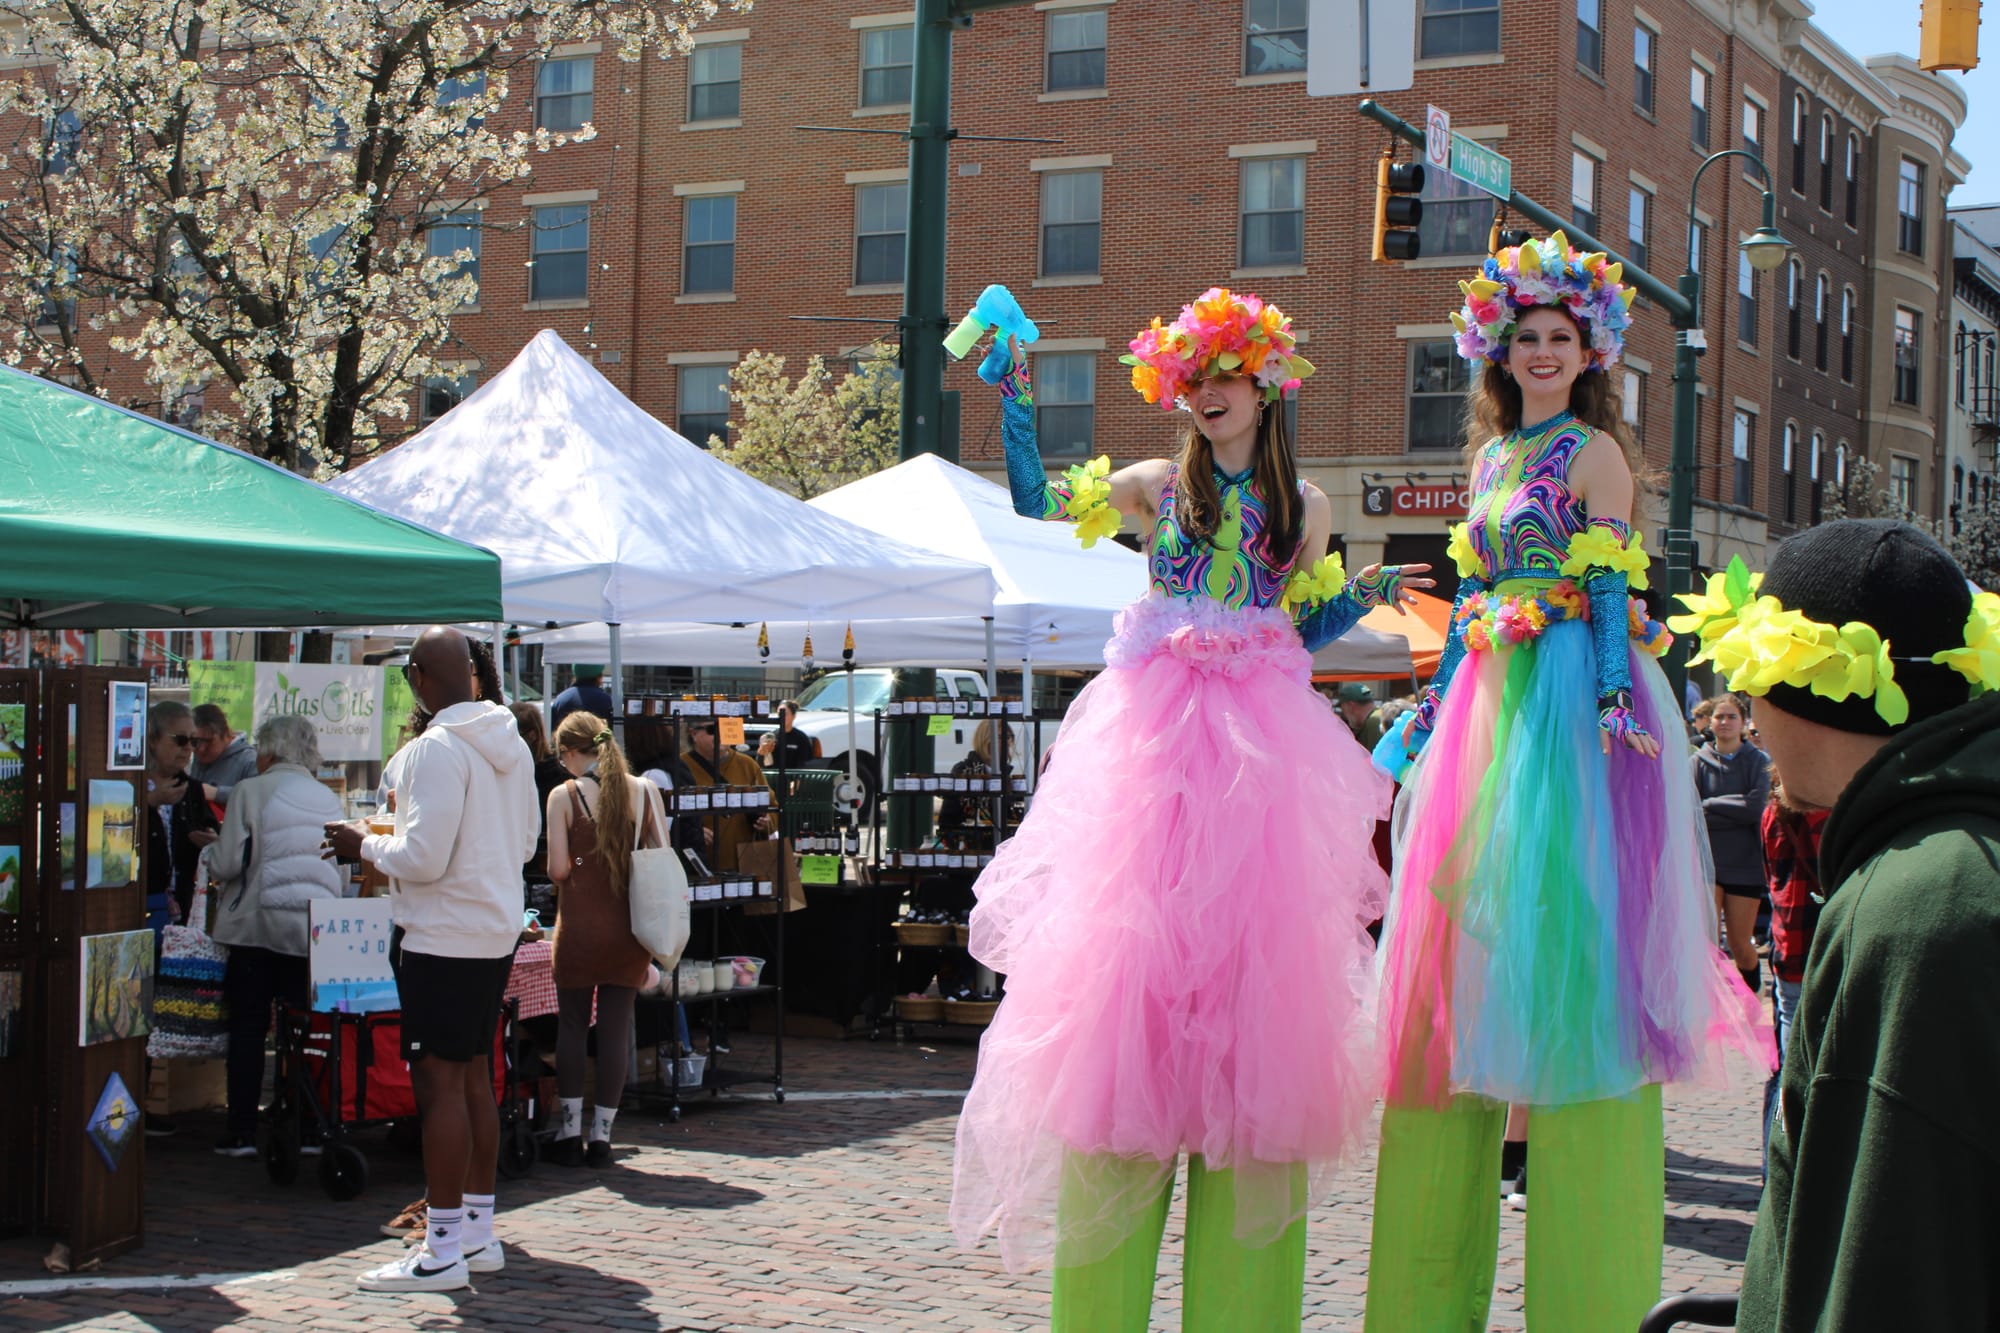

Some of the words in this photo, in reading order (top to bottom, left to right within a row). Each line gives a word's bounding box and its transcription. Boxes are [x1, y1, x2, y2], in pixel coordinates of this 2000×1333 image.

[1459, 143, 1486, 184] High
[1490, 159, 1504, 188] St
[264, 688, 319, 716] Atlas
[326, 724, 344, 735] Live
[327, 919, 364, 933] ART
